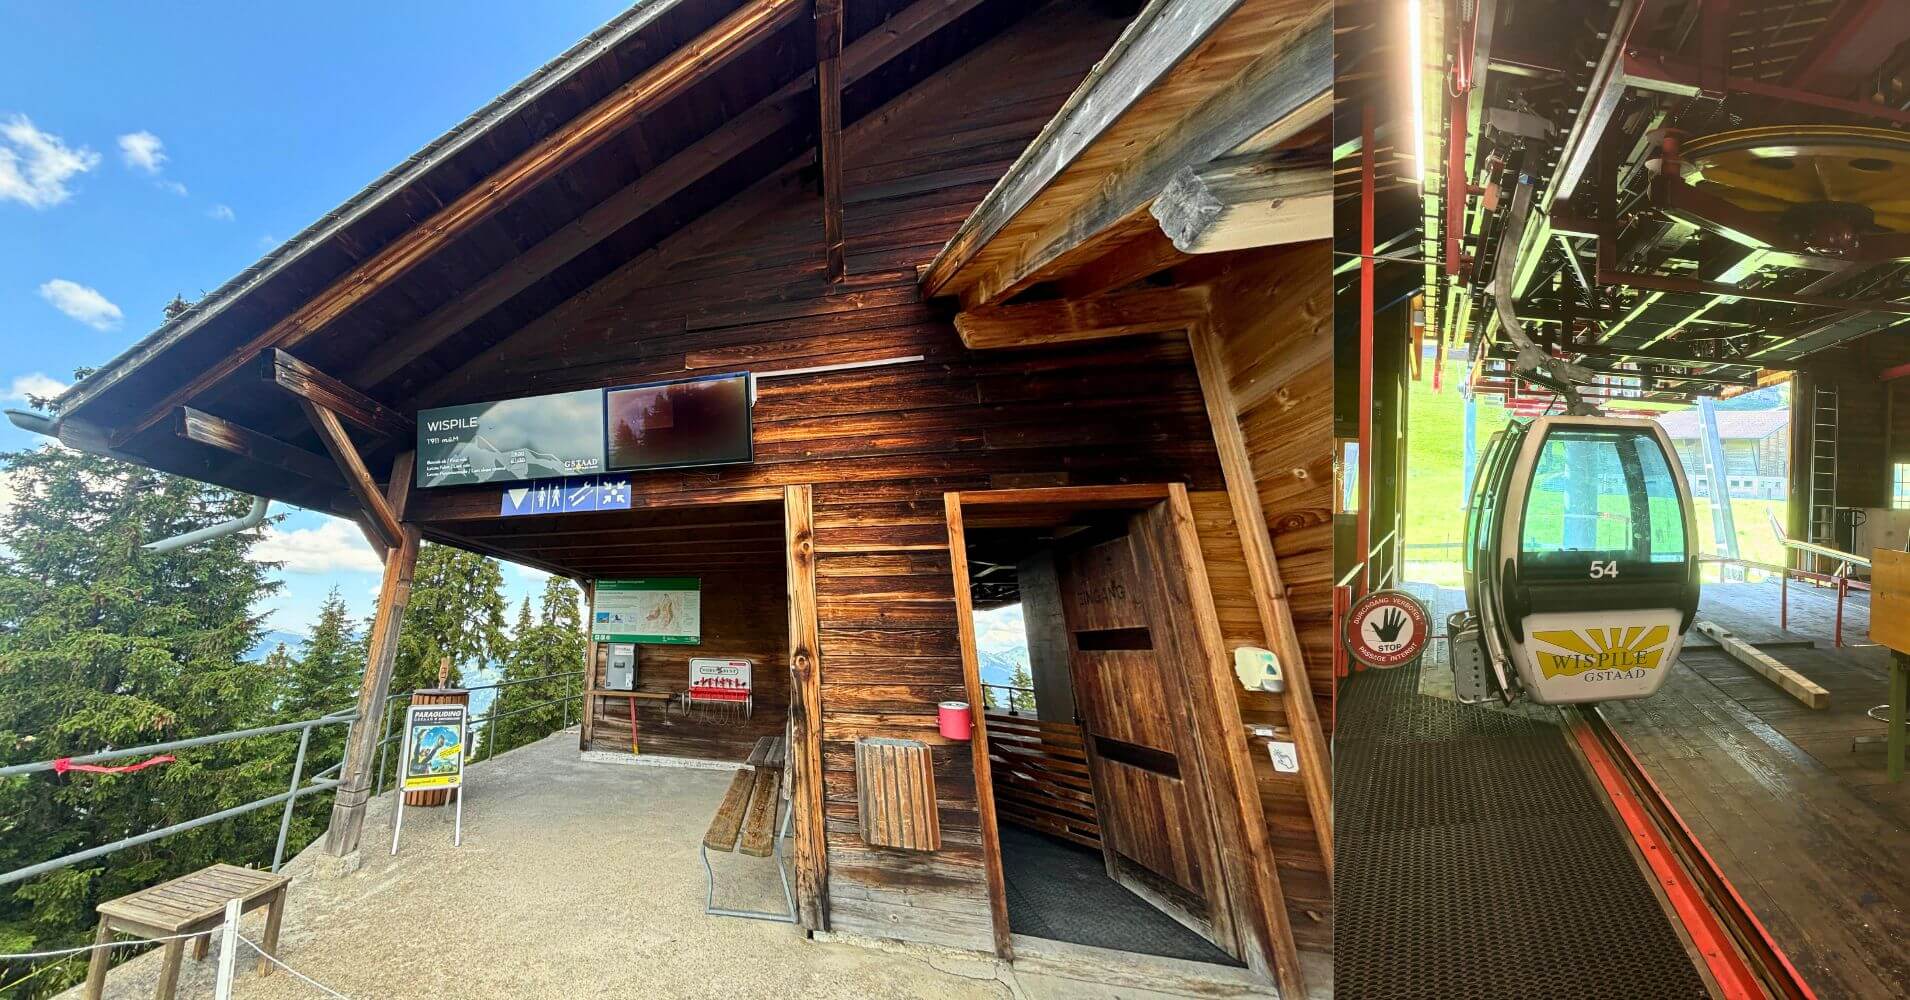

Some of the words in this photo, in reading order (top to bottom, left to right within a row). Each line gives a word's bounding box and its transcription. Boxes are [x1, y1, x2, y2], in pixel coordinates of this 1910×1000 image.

[427, 416, 479, 432] WISPILE
[564, 458, 598, 468] GSTAAD
[1589, 560, 1619, 579] 54
[1353, 597, 1389, 625] DURCHGANG
[1393, 597, 1421, 621] VERBOTEN
[1359, 646, 1387, 662] PASSAGE
[1390, 641, 1418, 662] INTERDIT
[1378, 643, 1402, 652] STOP
[1552, 650, 1648, 670] WISPILE
[1584, 669, 1646, 683] GSTAAD
[414, 710, 462, 719] PARAGLIDING
